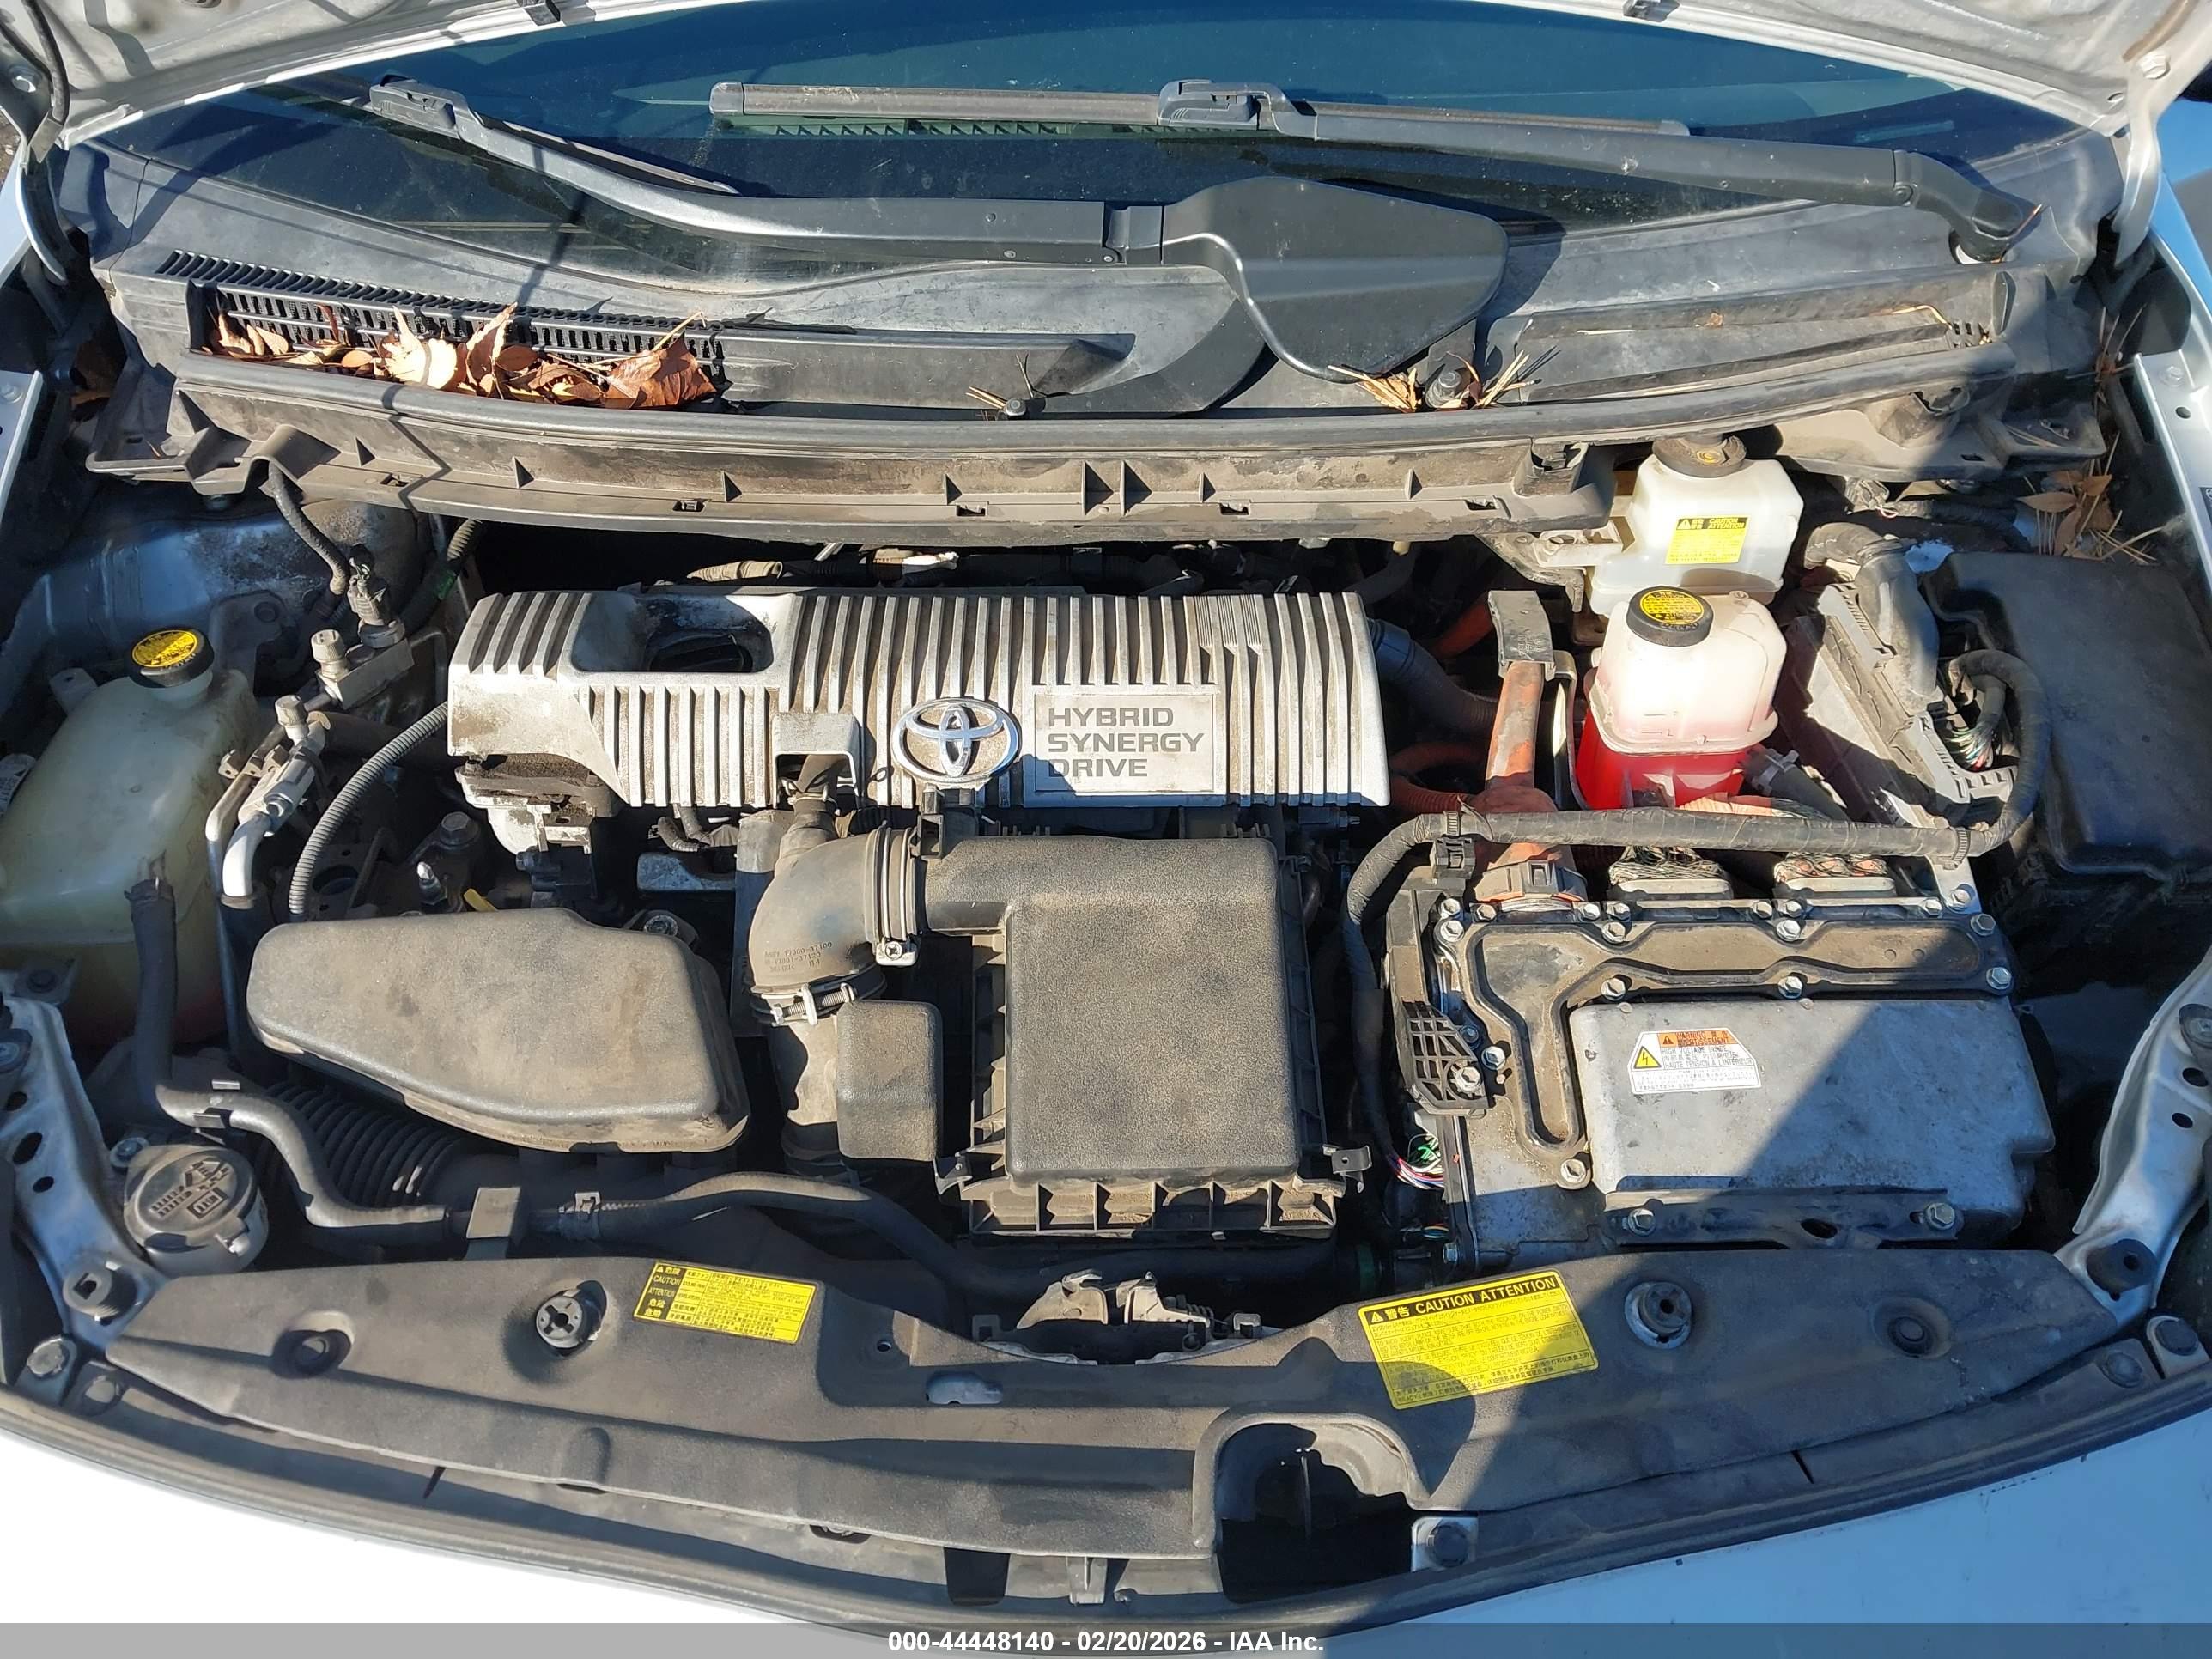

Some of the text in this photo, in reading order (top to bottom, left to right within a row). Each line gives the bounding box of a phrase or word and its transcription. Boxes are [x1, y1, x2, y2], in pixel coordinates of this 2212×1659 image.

[1048, 708, 1174, 727] HYBRID
[1048, 732, 1205, 752] SYNERGY
[1048, 758, 1148, 777] DRIVE
[653, 1275, 682, 1285] CAUTION
[648, 1287, 676, 1297] ATTENTION
[1384, 1277, 1556, 1321] 警告 CAUTION ATTENTION
